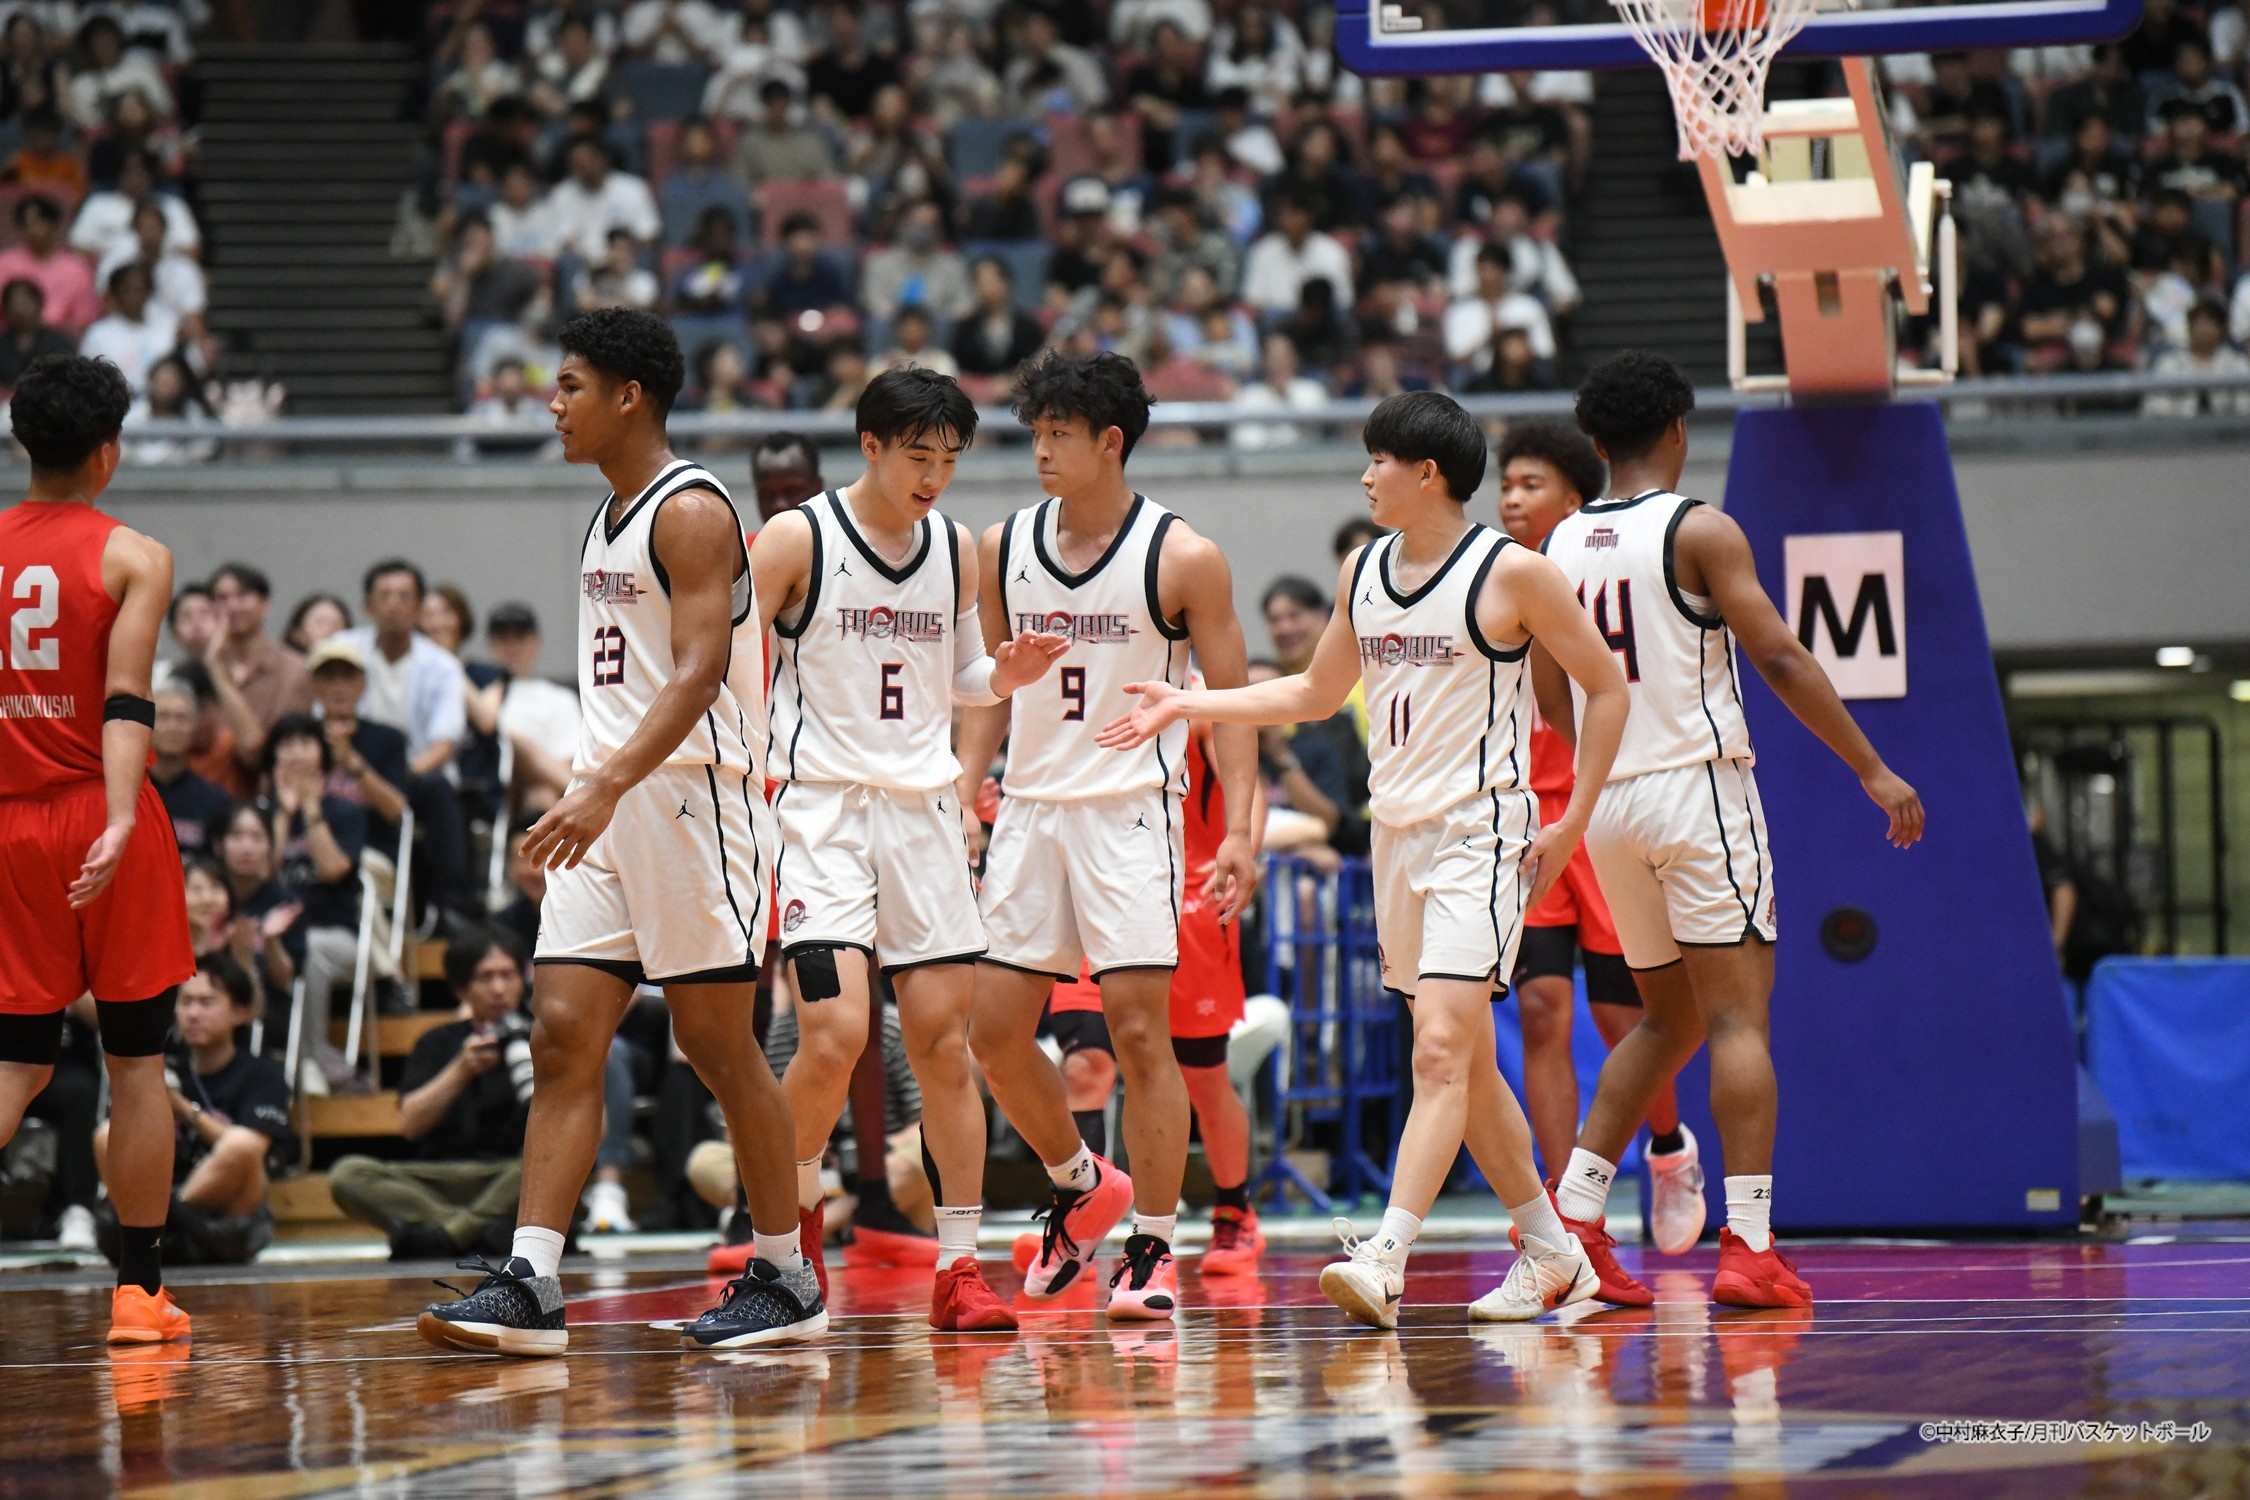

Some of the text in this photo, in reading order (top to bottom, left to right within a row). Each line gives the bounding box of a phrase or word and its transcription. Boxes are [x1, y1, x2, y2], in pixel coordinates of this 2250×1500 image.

[0, 565, 60, 671] 2
[1799, 572, 1898, 659] M
[593, 625, 627, 688] 23
[879, 662, 905, 721] 6
[1060, 666, 1086, 722] 9
[1389, 690, 1412, 747] 11
